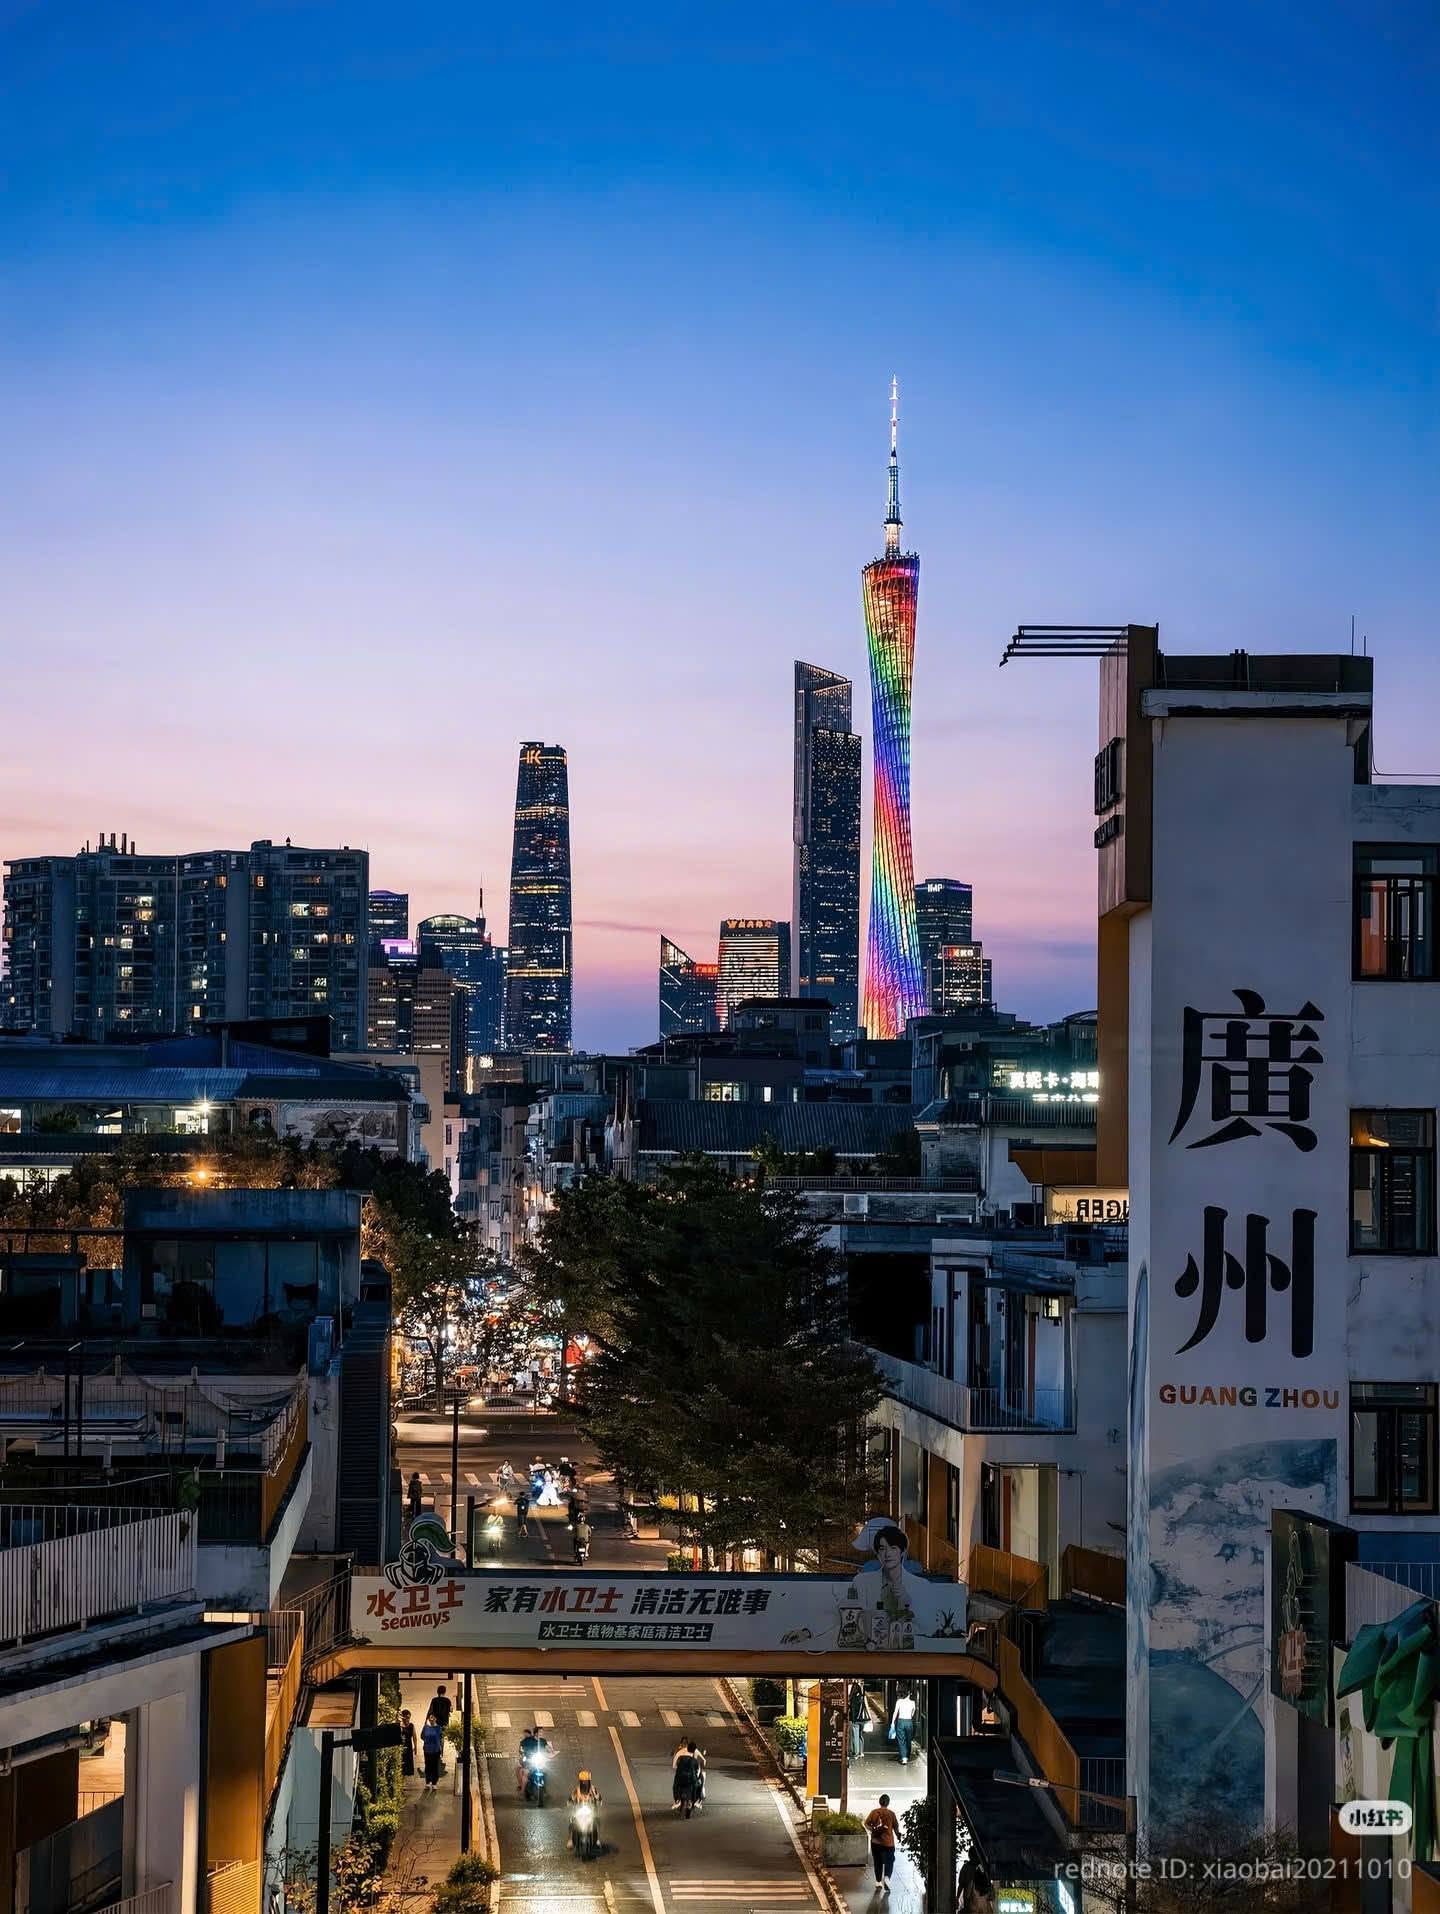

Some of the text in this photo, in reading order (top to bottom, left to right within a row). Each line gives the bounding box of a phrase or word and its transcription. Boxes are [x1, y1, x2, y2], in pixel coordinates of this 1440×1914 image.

[1167, 988, 1325, 1358] 廣州
[1158, 1383, 1341, 1410] GUANG ZHOU
[366, 1580, 466, 1617] 水卫士
[483, 1586, 769, 1616] 家有水卫士 清洁无难事
[380, 1611, 451, 1632] seaways
[542, 1623, 711, 1641] 水卫士 植物基家庭清洁卫士
